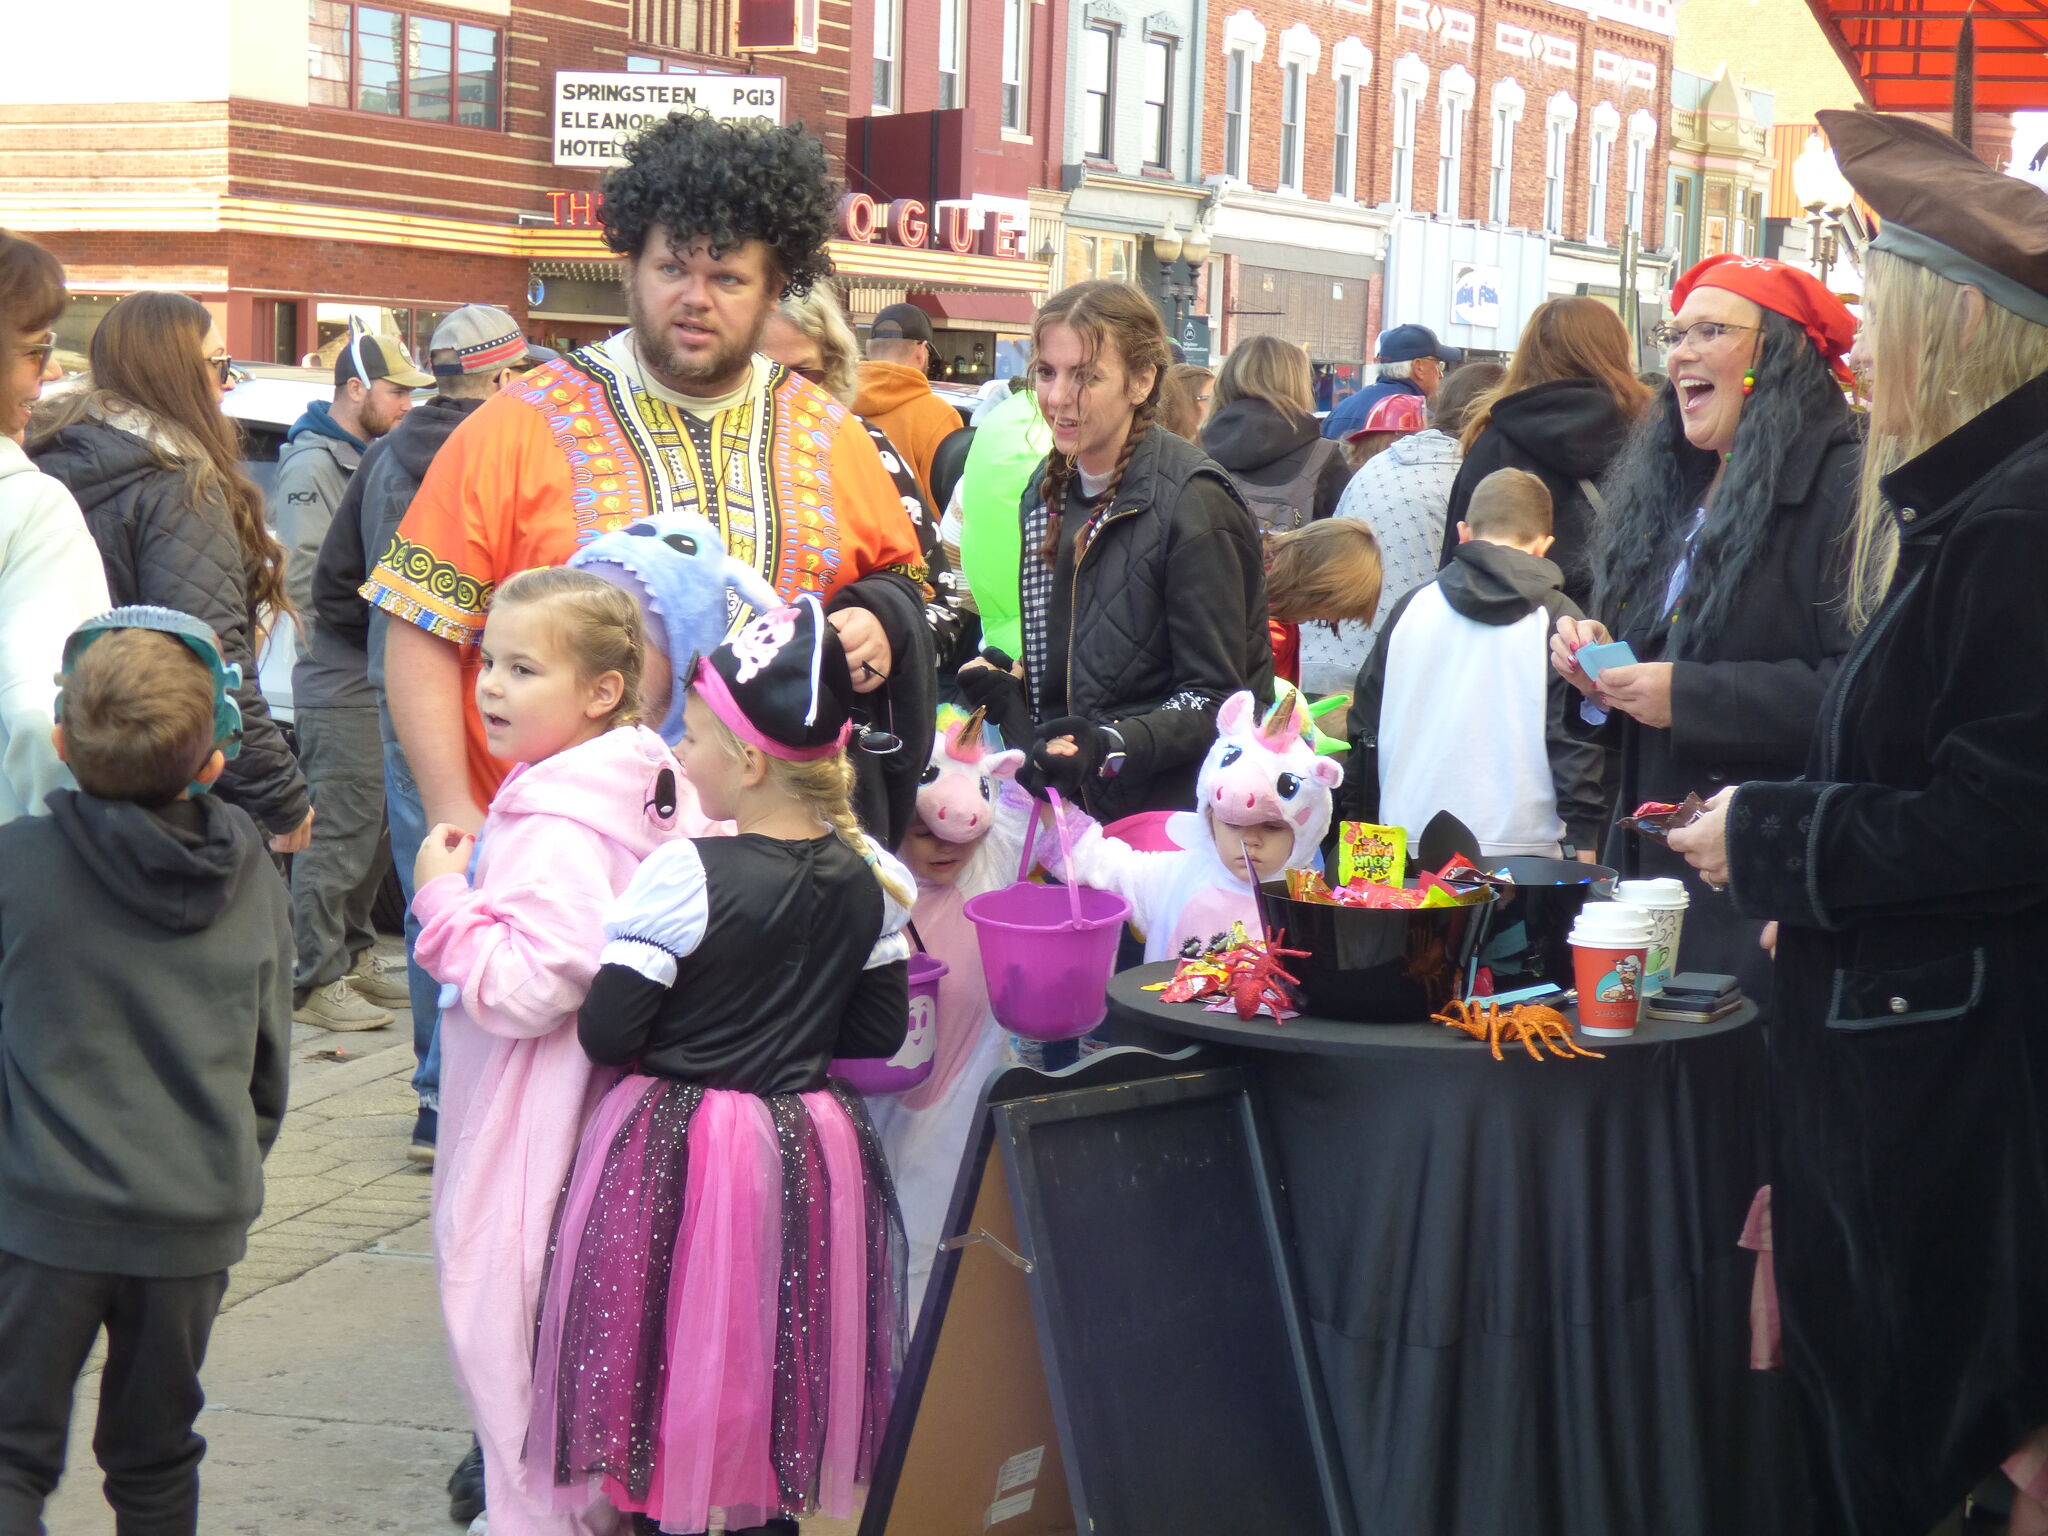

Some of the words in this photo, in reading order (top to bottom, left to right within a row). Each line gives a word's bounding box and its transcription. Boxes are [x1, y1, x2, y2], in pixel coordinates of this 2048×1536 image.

[562, 83, 696, 104] SPRINGSTEEN
[733, 88, 776, 106] PG13
[843, 192, 1018, 258] OGUE
[1352, 843, 1393, 857] PATCH
[1353, 855, 1392, 869] SOUR
